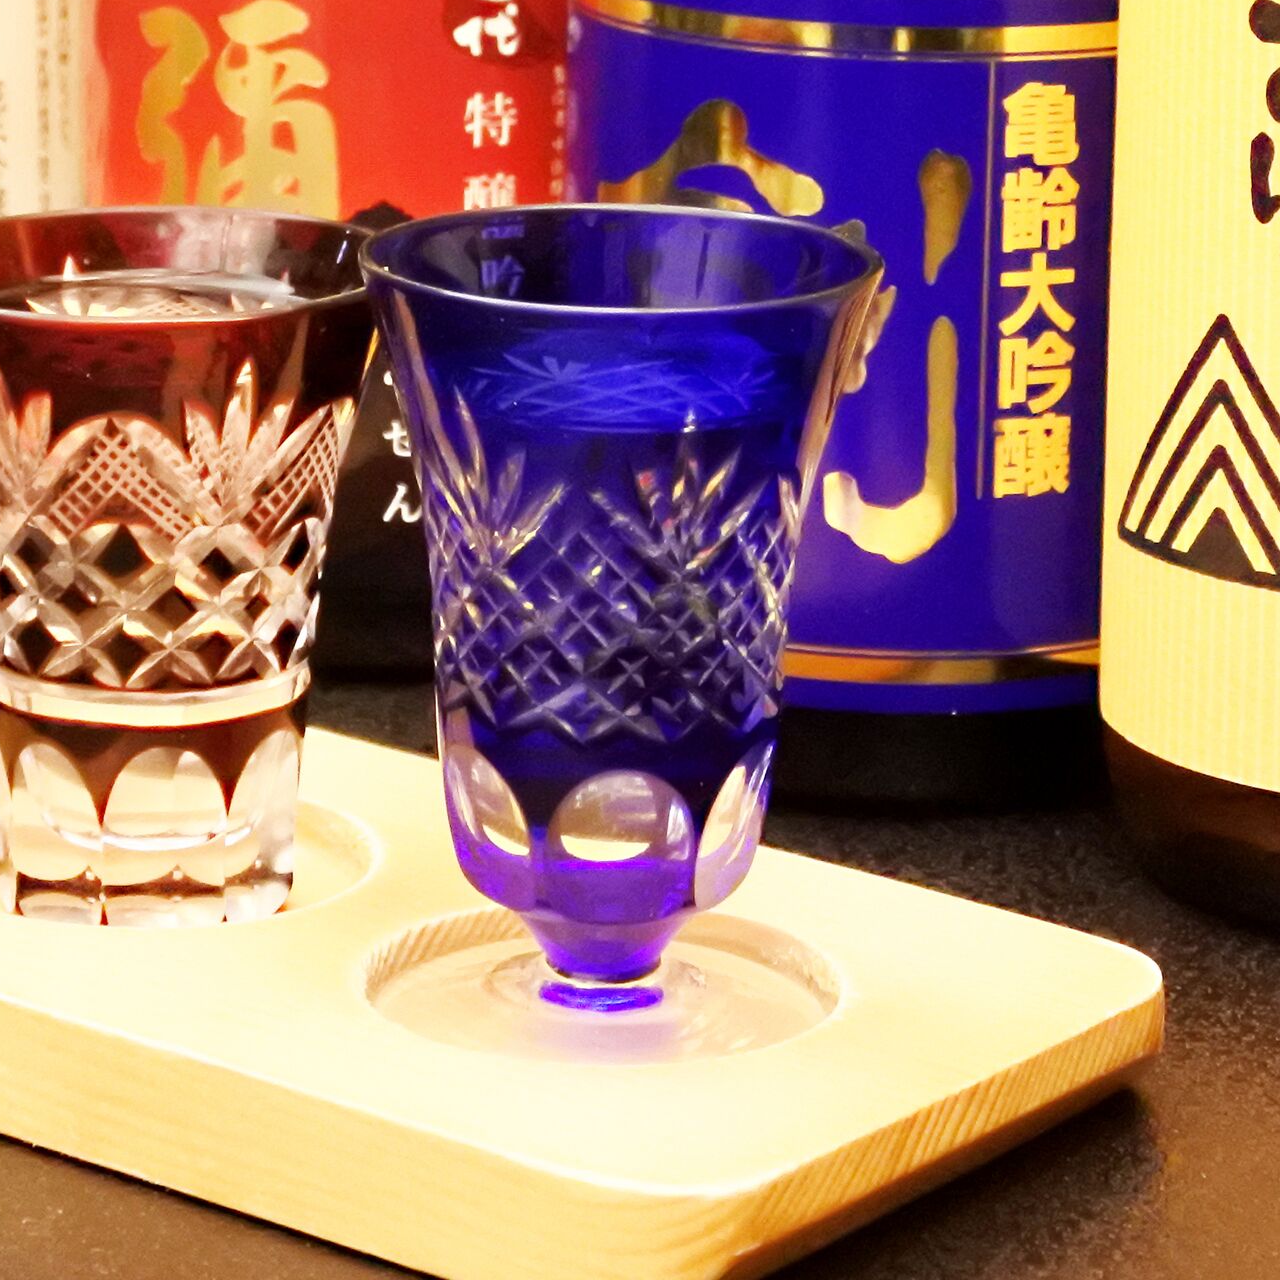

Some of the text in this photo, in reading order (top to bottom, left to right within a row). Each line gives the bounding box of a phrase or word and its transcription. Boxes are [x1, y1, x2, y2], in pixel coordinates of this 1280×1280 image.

[992, 81, 1081, 500] 亀齢大吟醸
